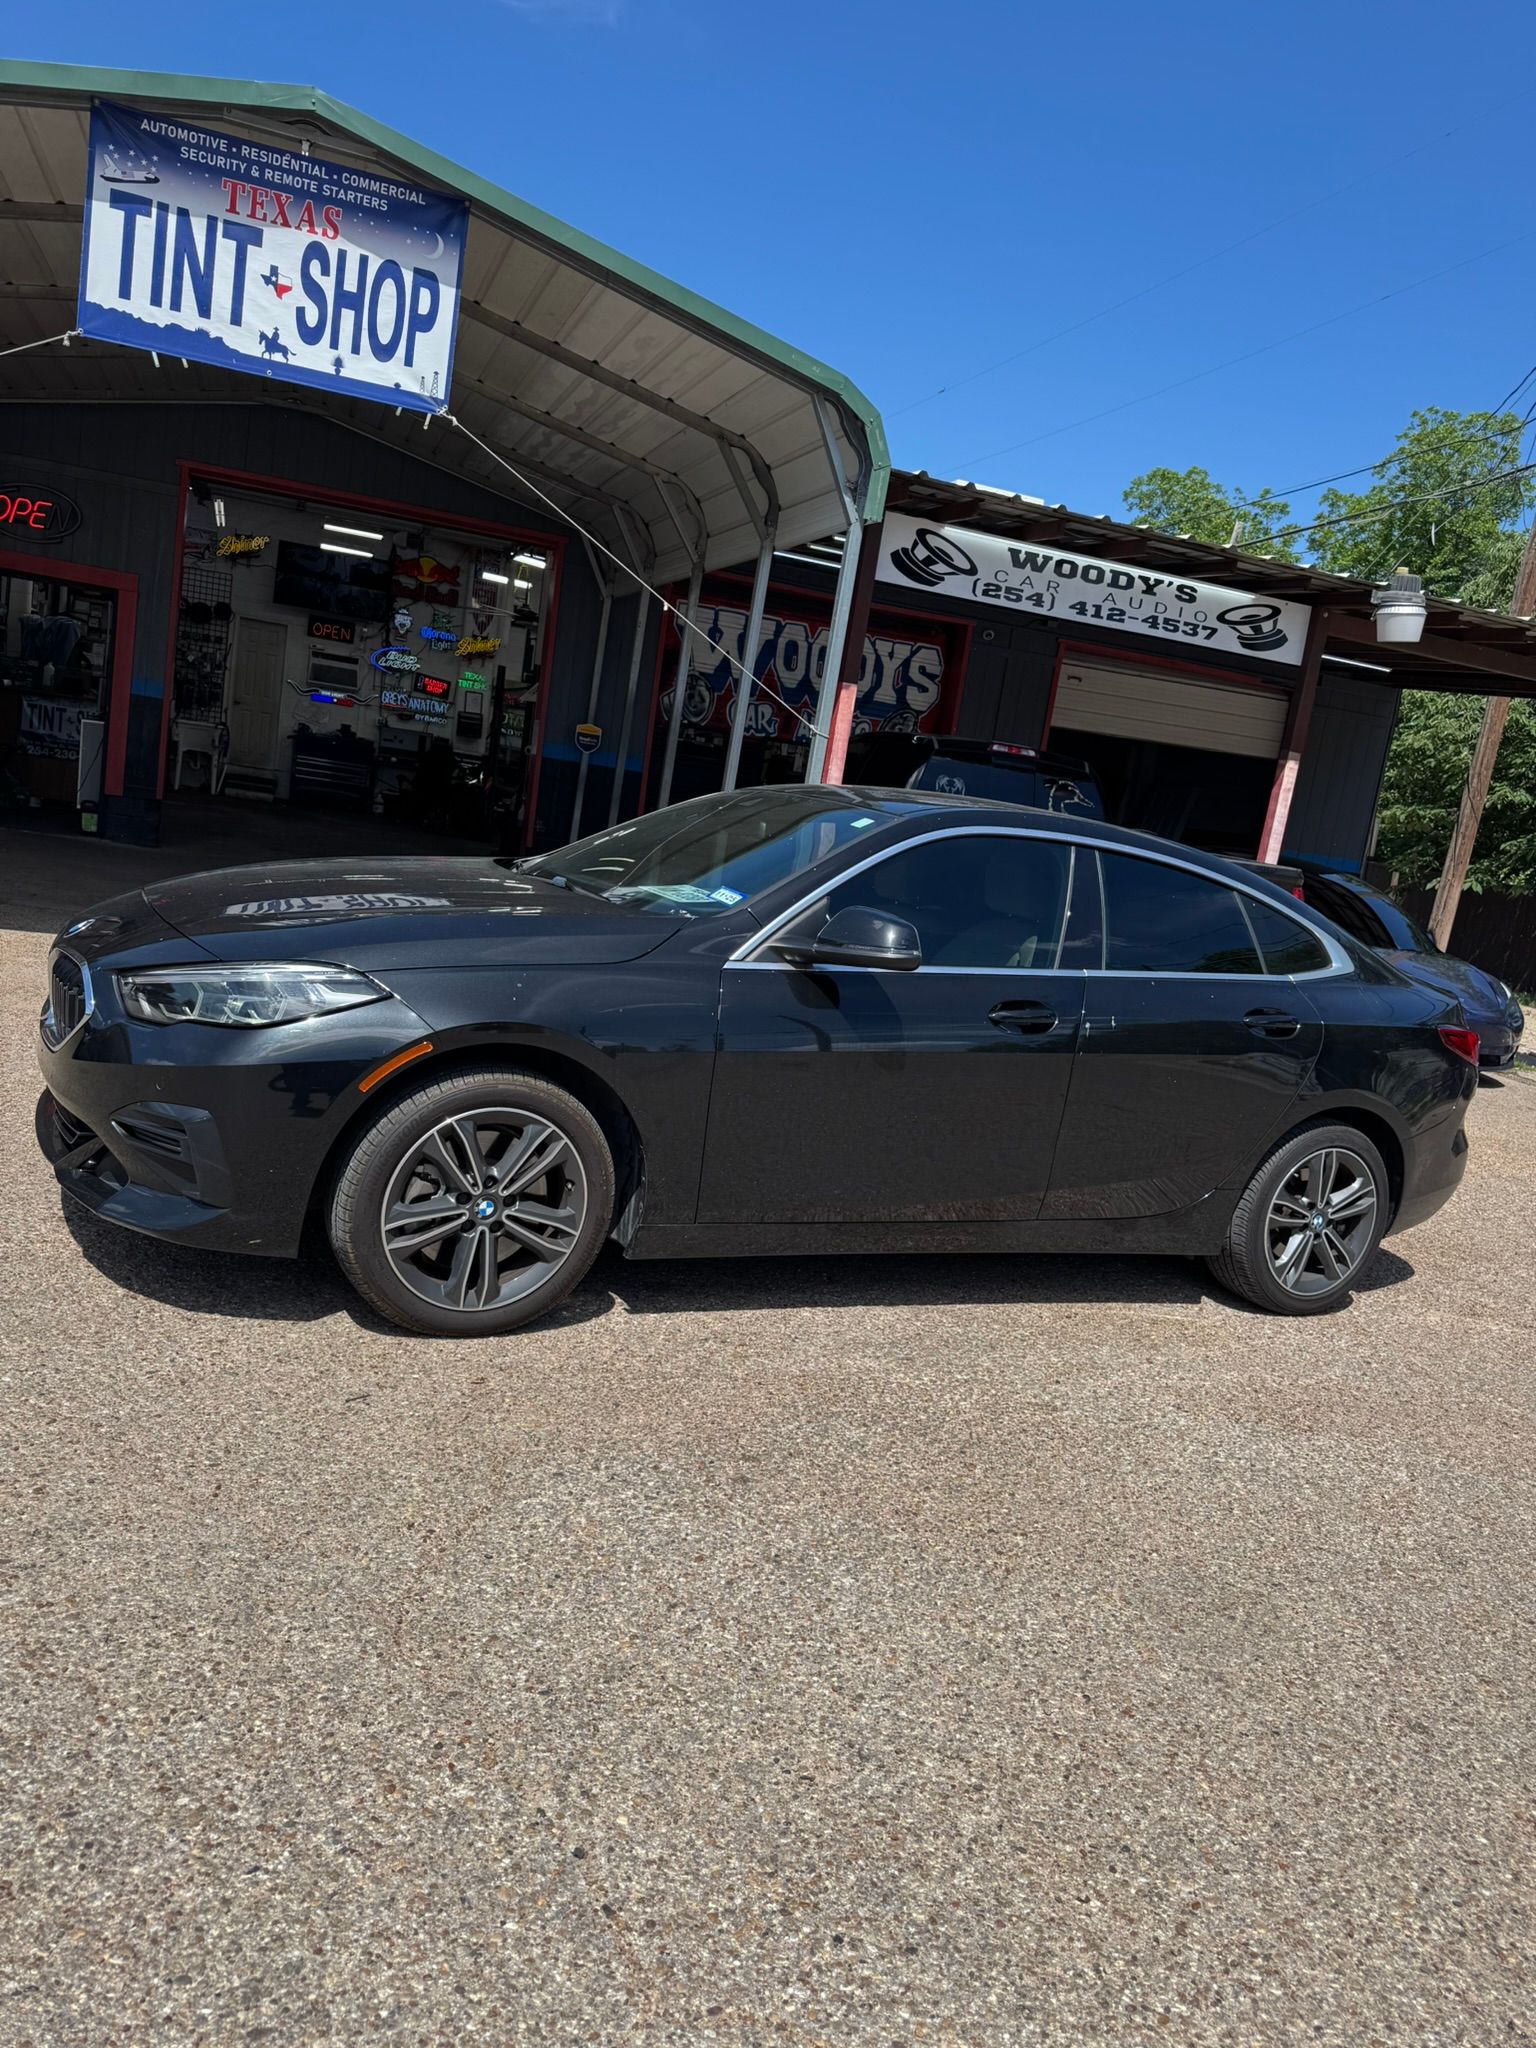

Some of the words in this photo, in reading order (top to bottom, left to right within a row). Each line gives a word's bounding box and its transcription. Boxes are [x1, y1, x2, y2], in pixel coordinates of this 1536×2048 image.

[140, 118, 228, 151] AUTOMOTIVE
[241, 147, 329, 179] RESIDENTIAL
[341, 173, 426, 205] COMMERCIAL
[180, 146, 247, 174] SECURITY
[250, 164, 260, 178] &
[264, 168, 318, 194] REMOTE
[322, 184, 388, 211] STARTERS
[221, 178, 342, 240] TEXAS
[109, 188, 264, 327] TINT
[295, 240, 440, 367] SHOP
[994, 569, 1061, 594] CAR
[1102, 592, 1208, 623] AUDIO
[1007, 547, 1198, 603] WOODY'S
[312, 622, 351, 641] OPEN
[420, 626, 457, 641] Corona
[971, 578, 1056, 611] (254)
[1069, 600, 1218, 641] 412-4537
[407, 698, 449, 714] ANATOMY
